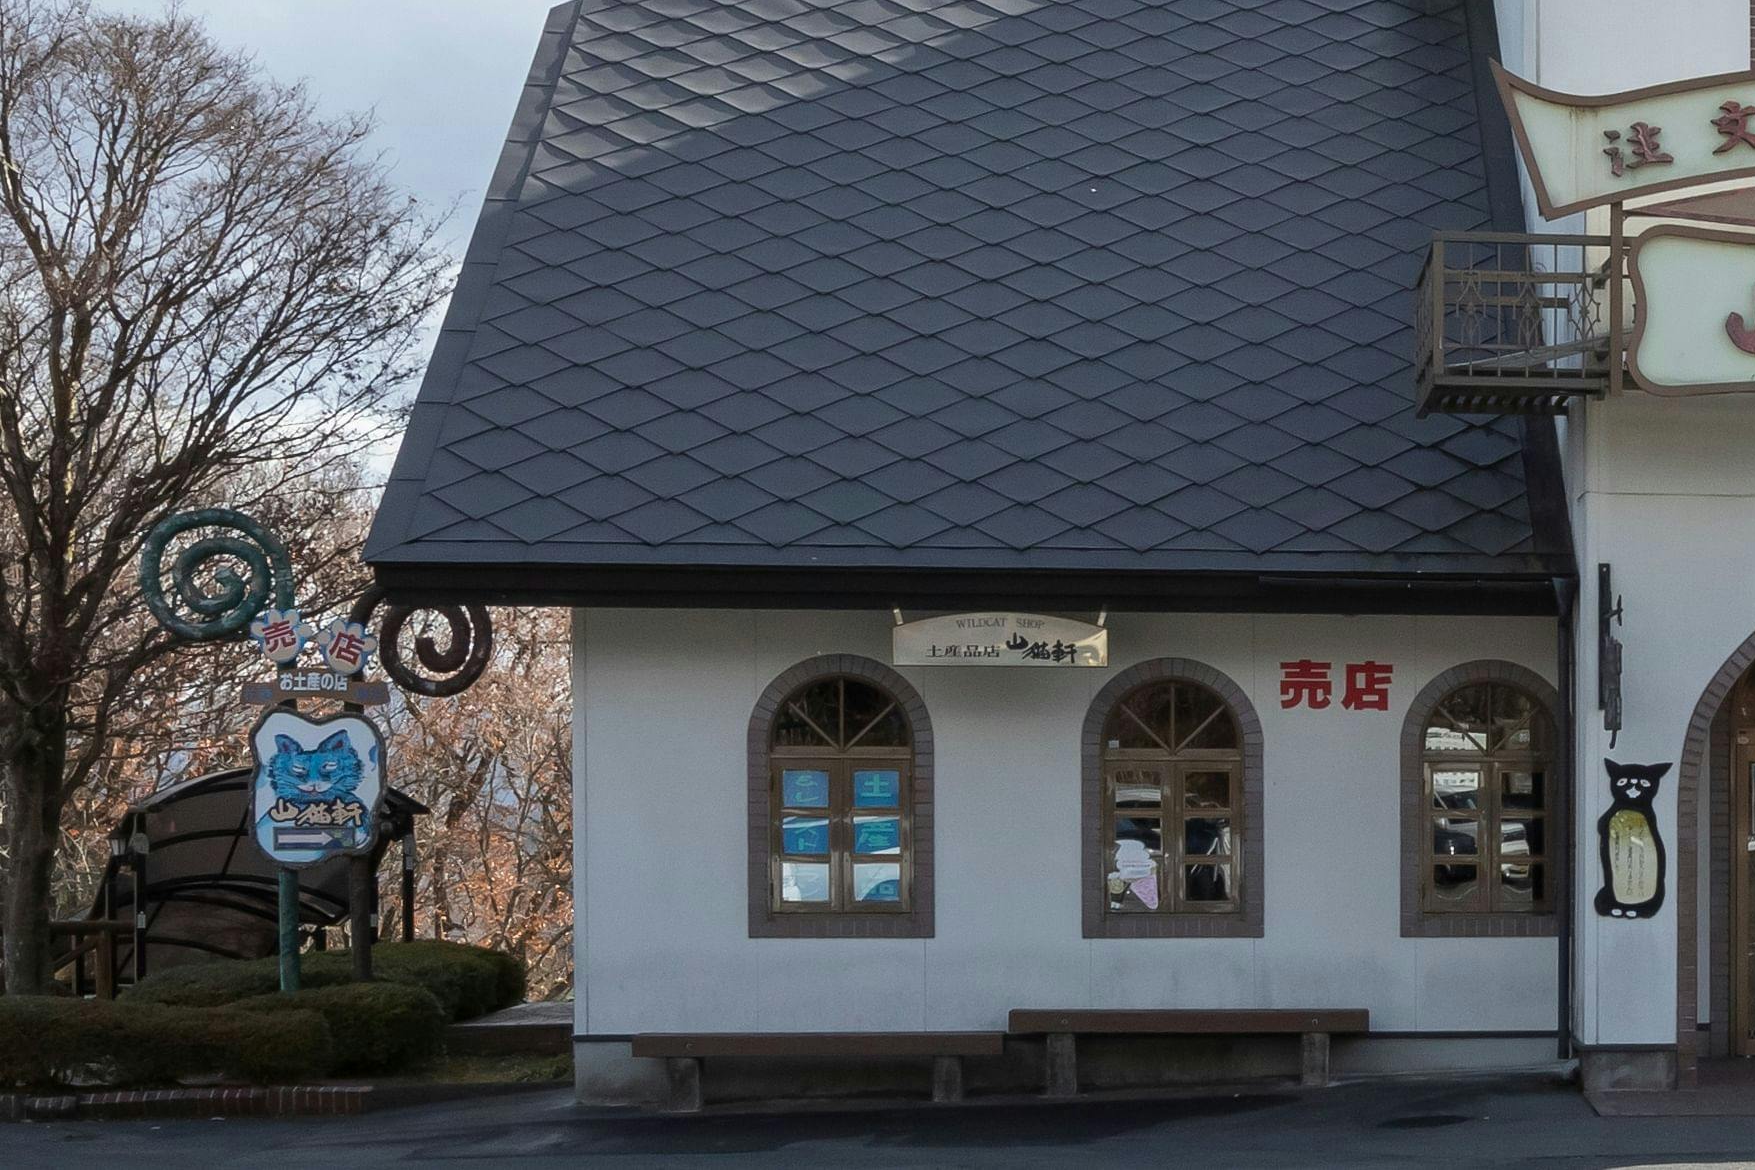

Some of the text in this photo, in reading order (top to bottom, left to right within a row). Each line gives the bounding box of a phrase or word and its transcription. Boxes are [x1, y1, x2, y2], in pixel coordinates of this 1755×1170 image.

[956, 617, 1045, 629] WILDCAT SHOP
[262, 620, 365, 666] 売店
[925, 632, 1078, 664] 土産品店 山猫軒
[280, 672, 348, 692] お土産の店
[1280, 659, 1393, 711] 売店
[270, 798, 363, 827] 山猫軒
